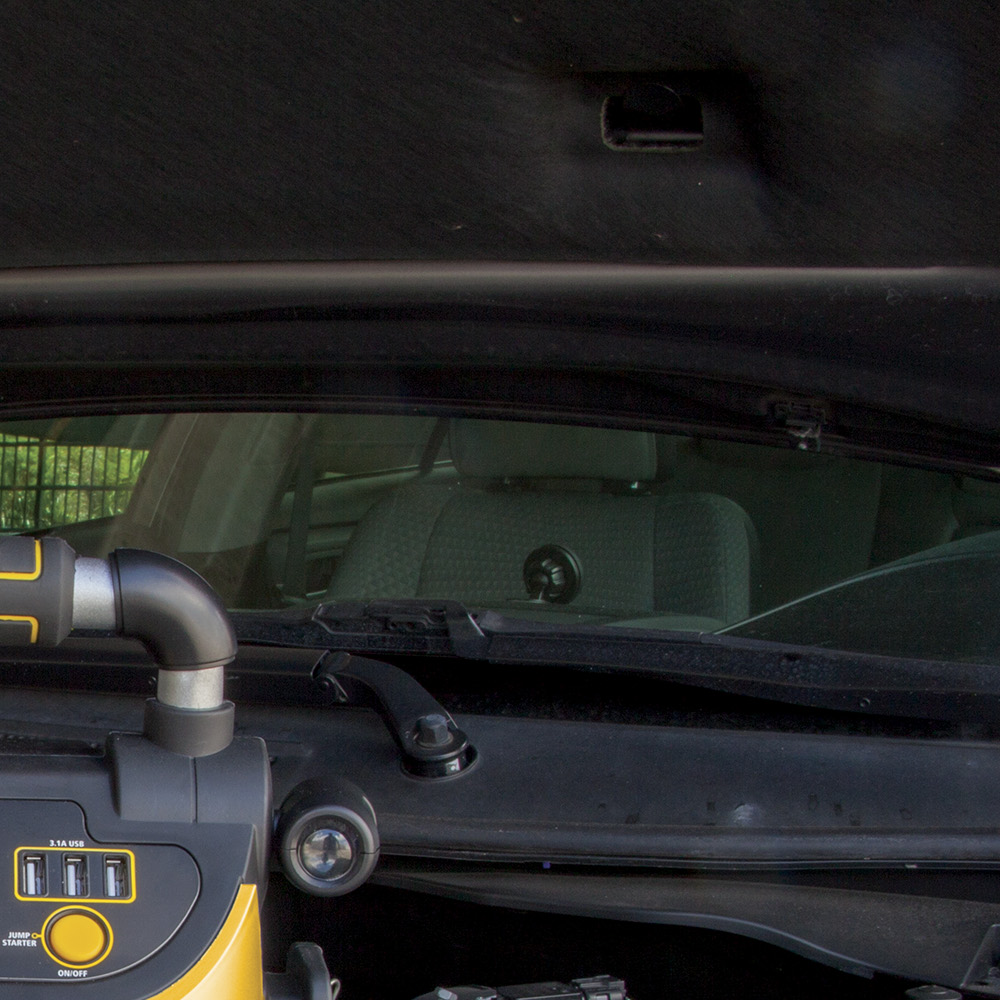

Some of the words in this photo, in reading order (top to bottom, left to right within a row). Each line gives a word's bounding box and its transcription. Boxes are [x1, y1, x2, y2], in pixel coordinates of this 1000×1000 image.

[49, 839, 67, 847] 3.1A
[68, 840, 85, 848] USB
[8, 931, 31, 939] JUMP
[1, 939, 37, 947] STARTER
[57, 969, 88, 978] ON/OFF
